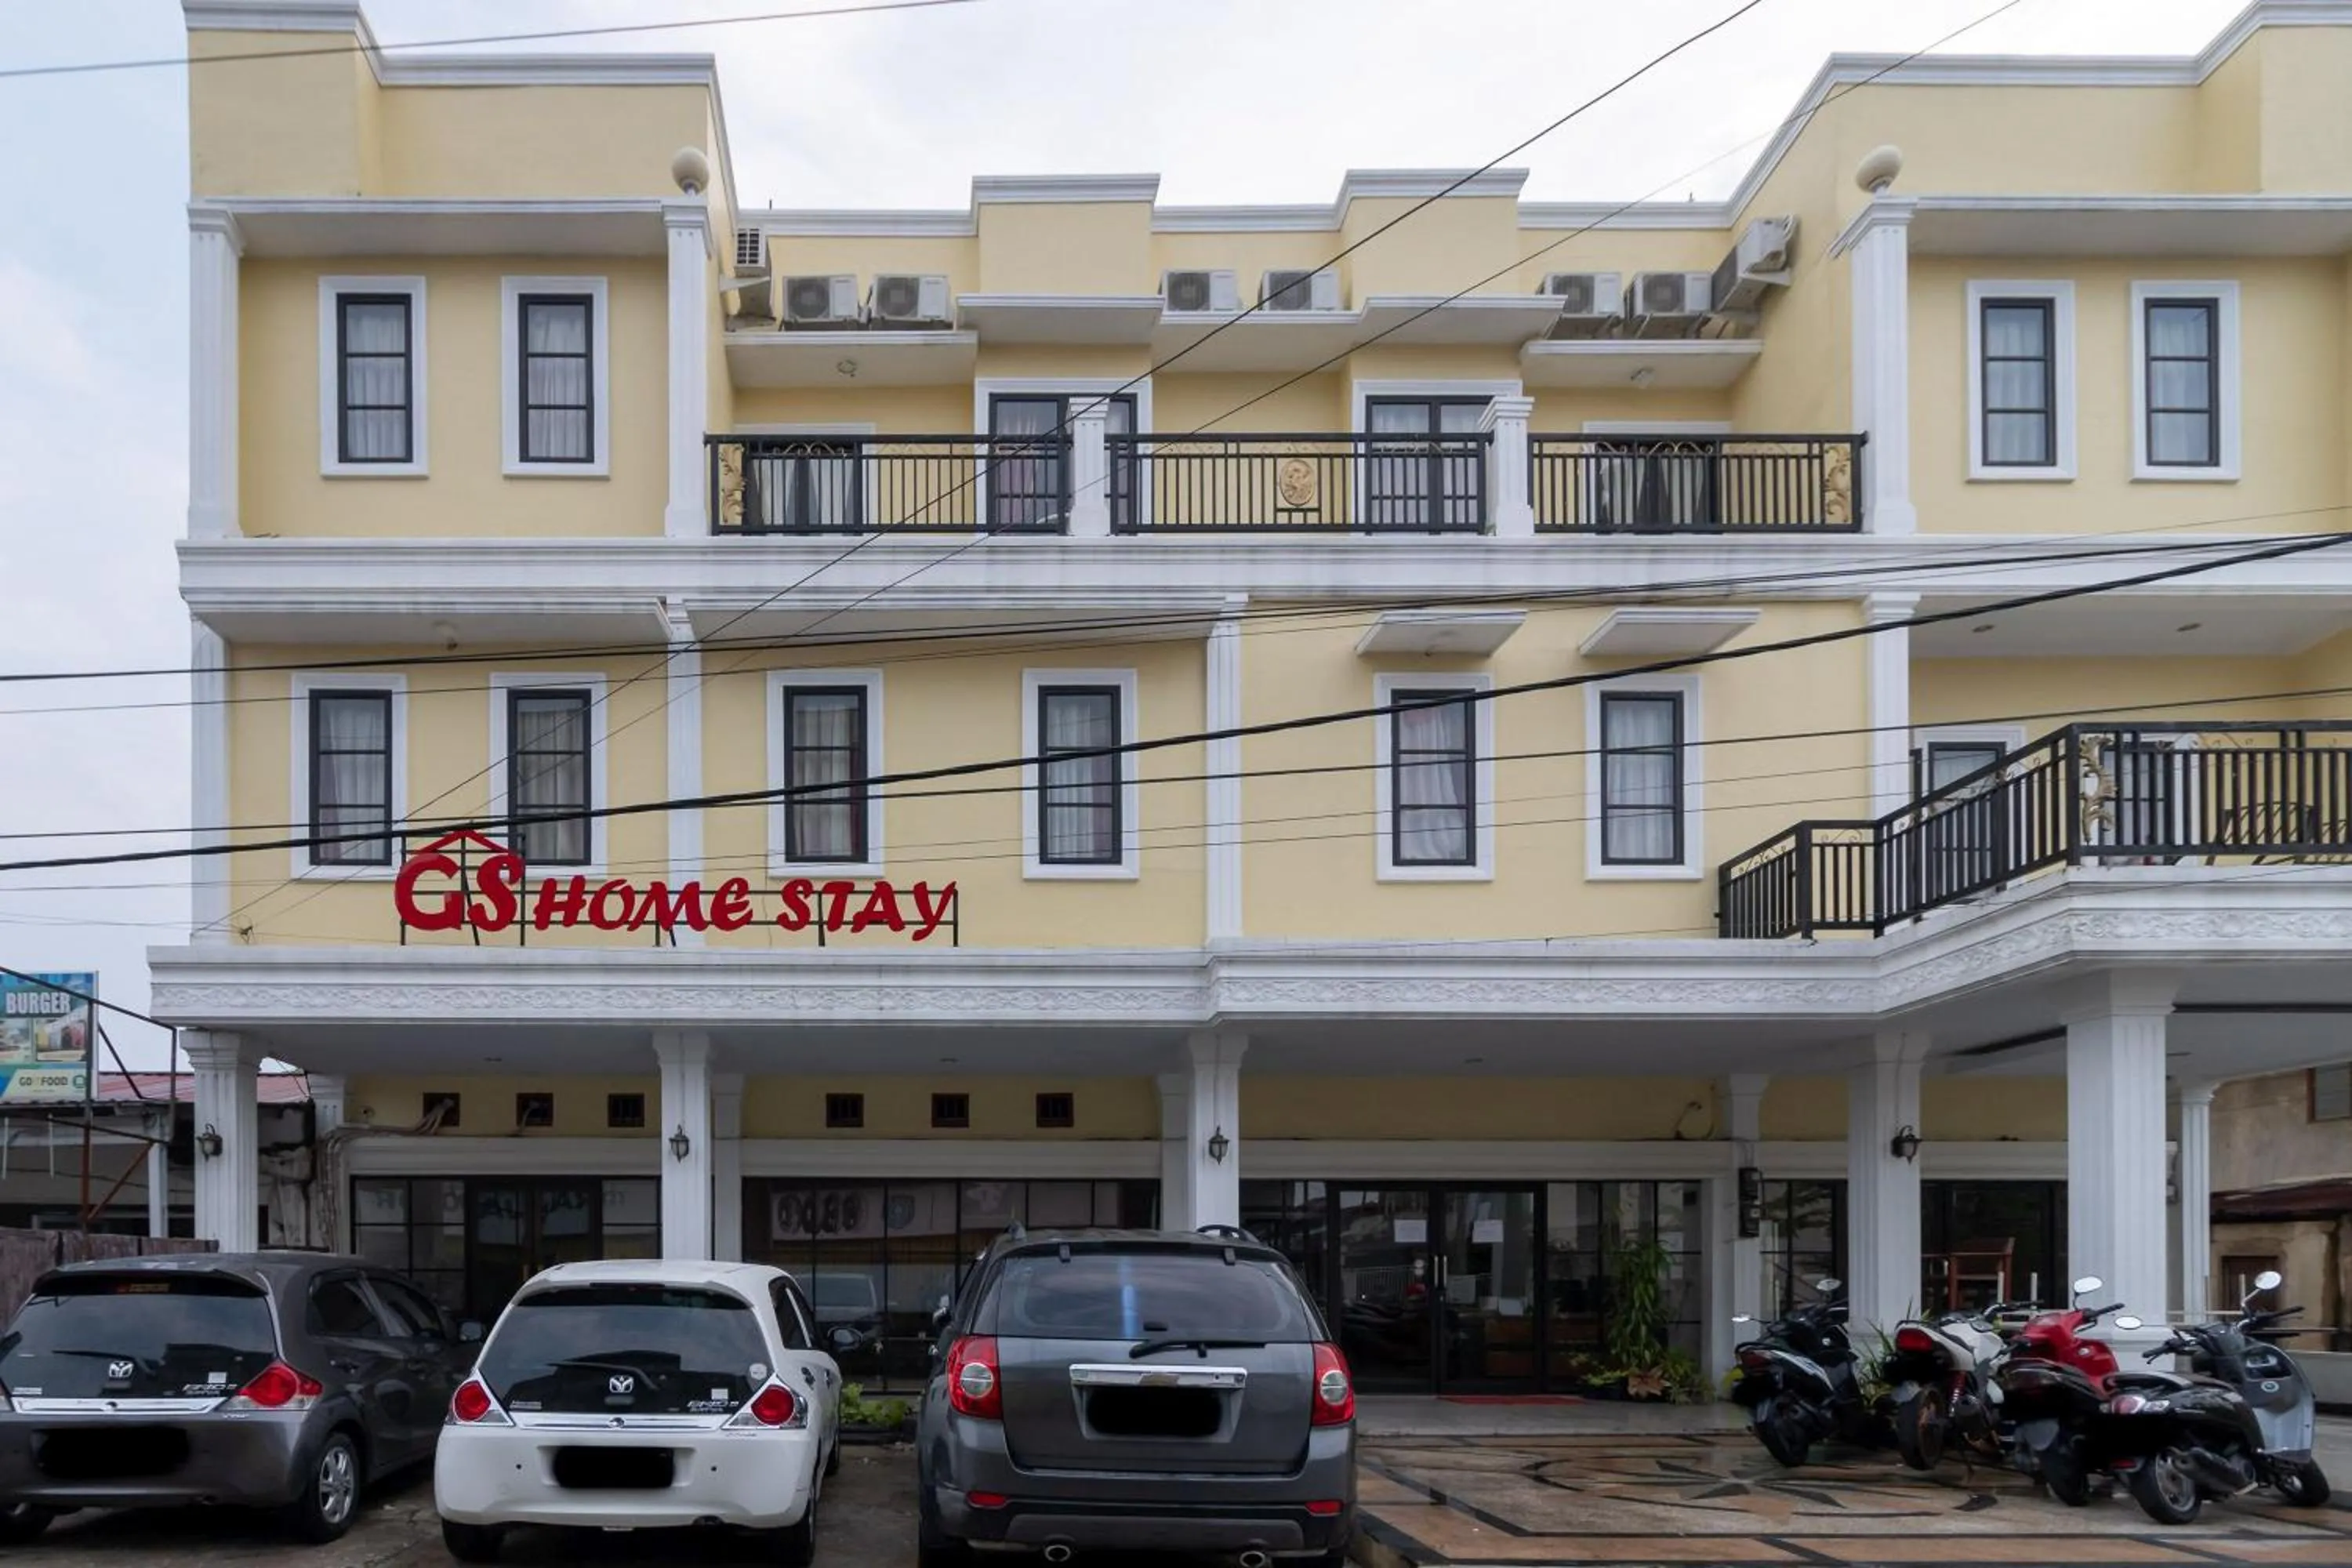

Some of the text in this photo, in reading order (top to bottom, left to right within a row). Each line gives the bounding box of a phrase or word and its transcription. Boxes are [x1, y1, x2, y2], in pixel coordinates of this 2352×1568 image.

[394, 851, 525, 931] GS
[777, 878, 956, 942] STAY
[6, 992, 71, 1014] BURGER
